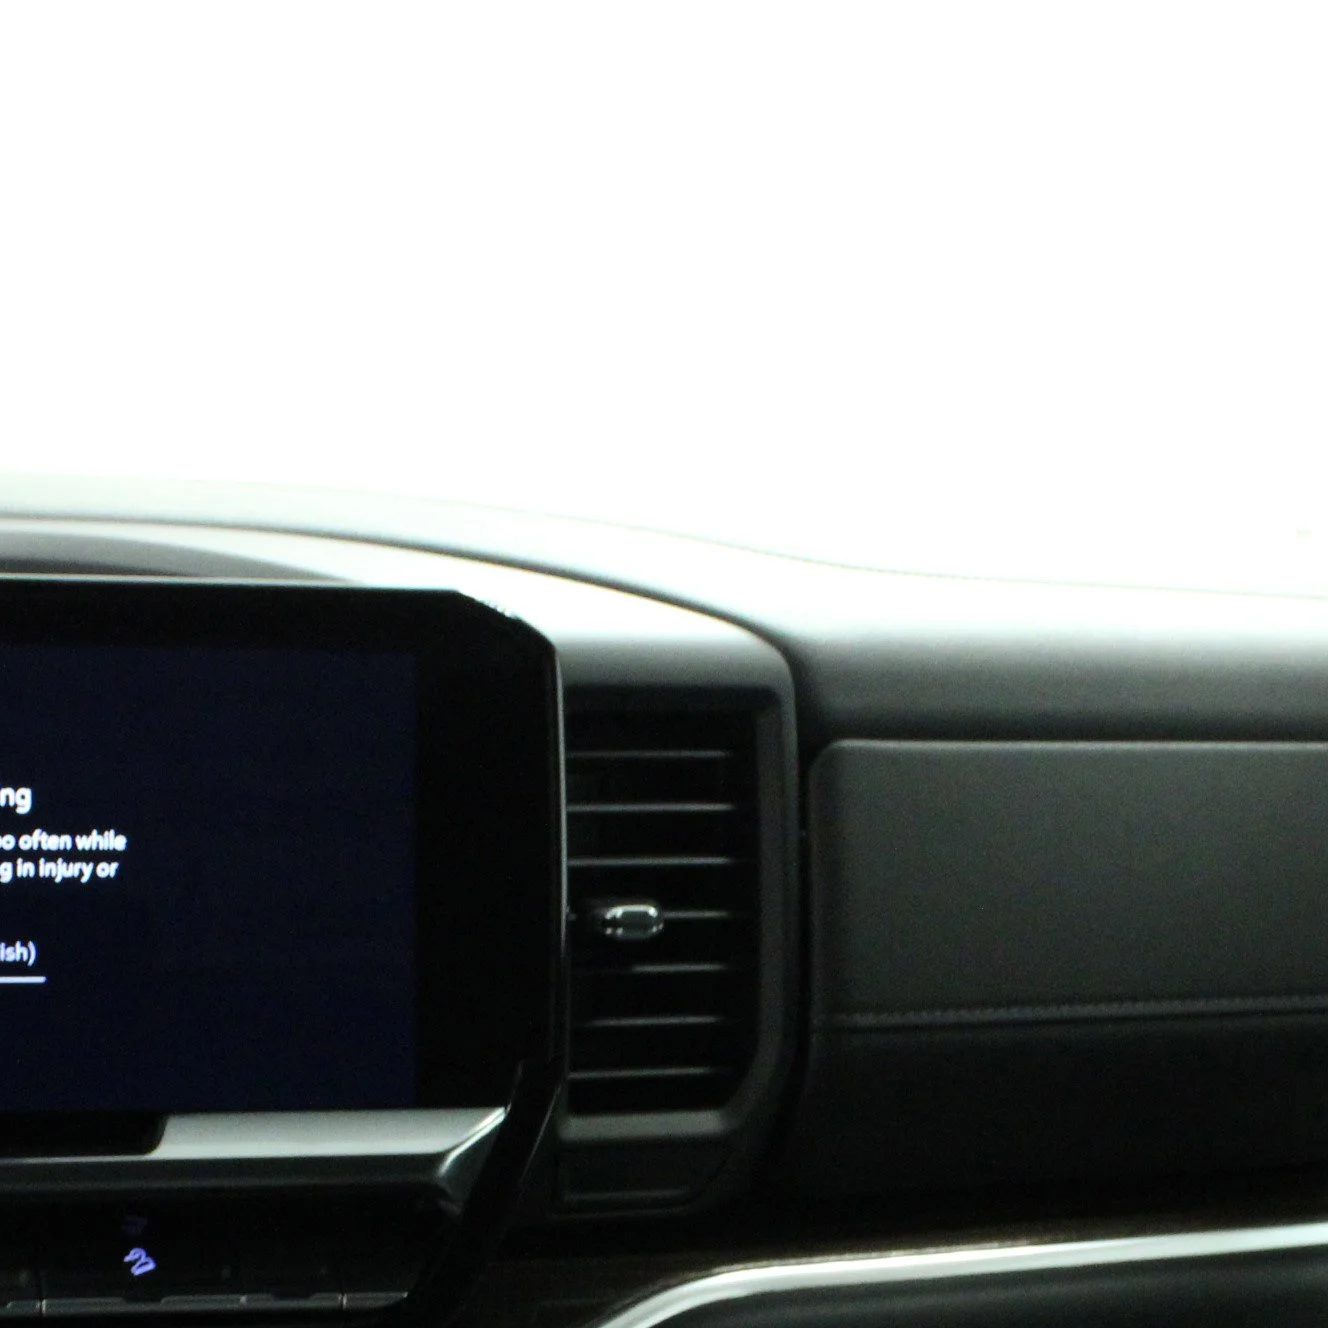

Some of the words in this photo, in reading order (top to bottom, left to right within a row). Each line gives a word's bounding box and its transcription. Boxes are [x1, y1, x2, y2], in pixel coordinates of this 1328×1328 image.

[18, 828, 72, 851] often
[74, 829, 128, 851] while
[16, 858, 35, 878] in
[38, 858, 94, 884] injury
[96, 861, 119, 878] or
